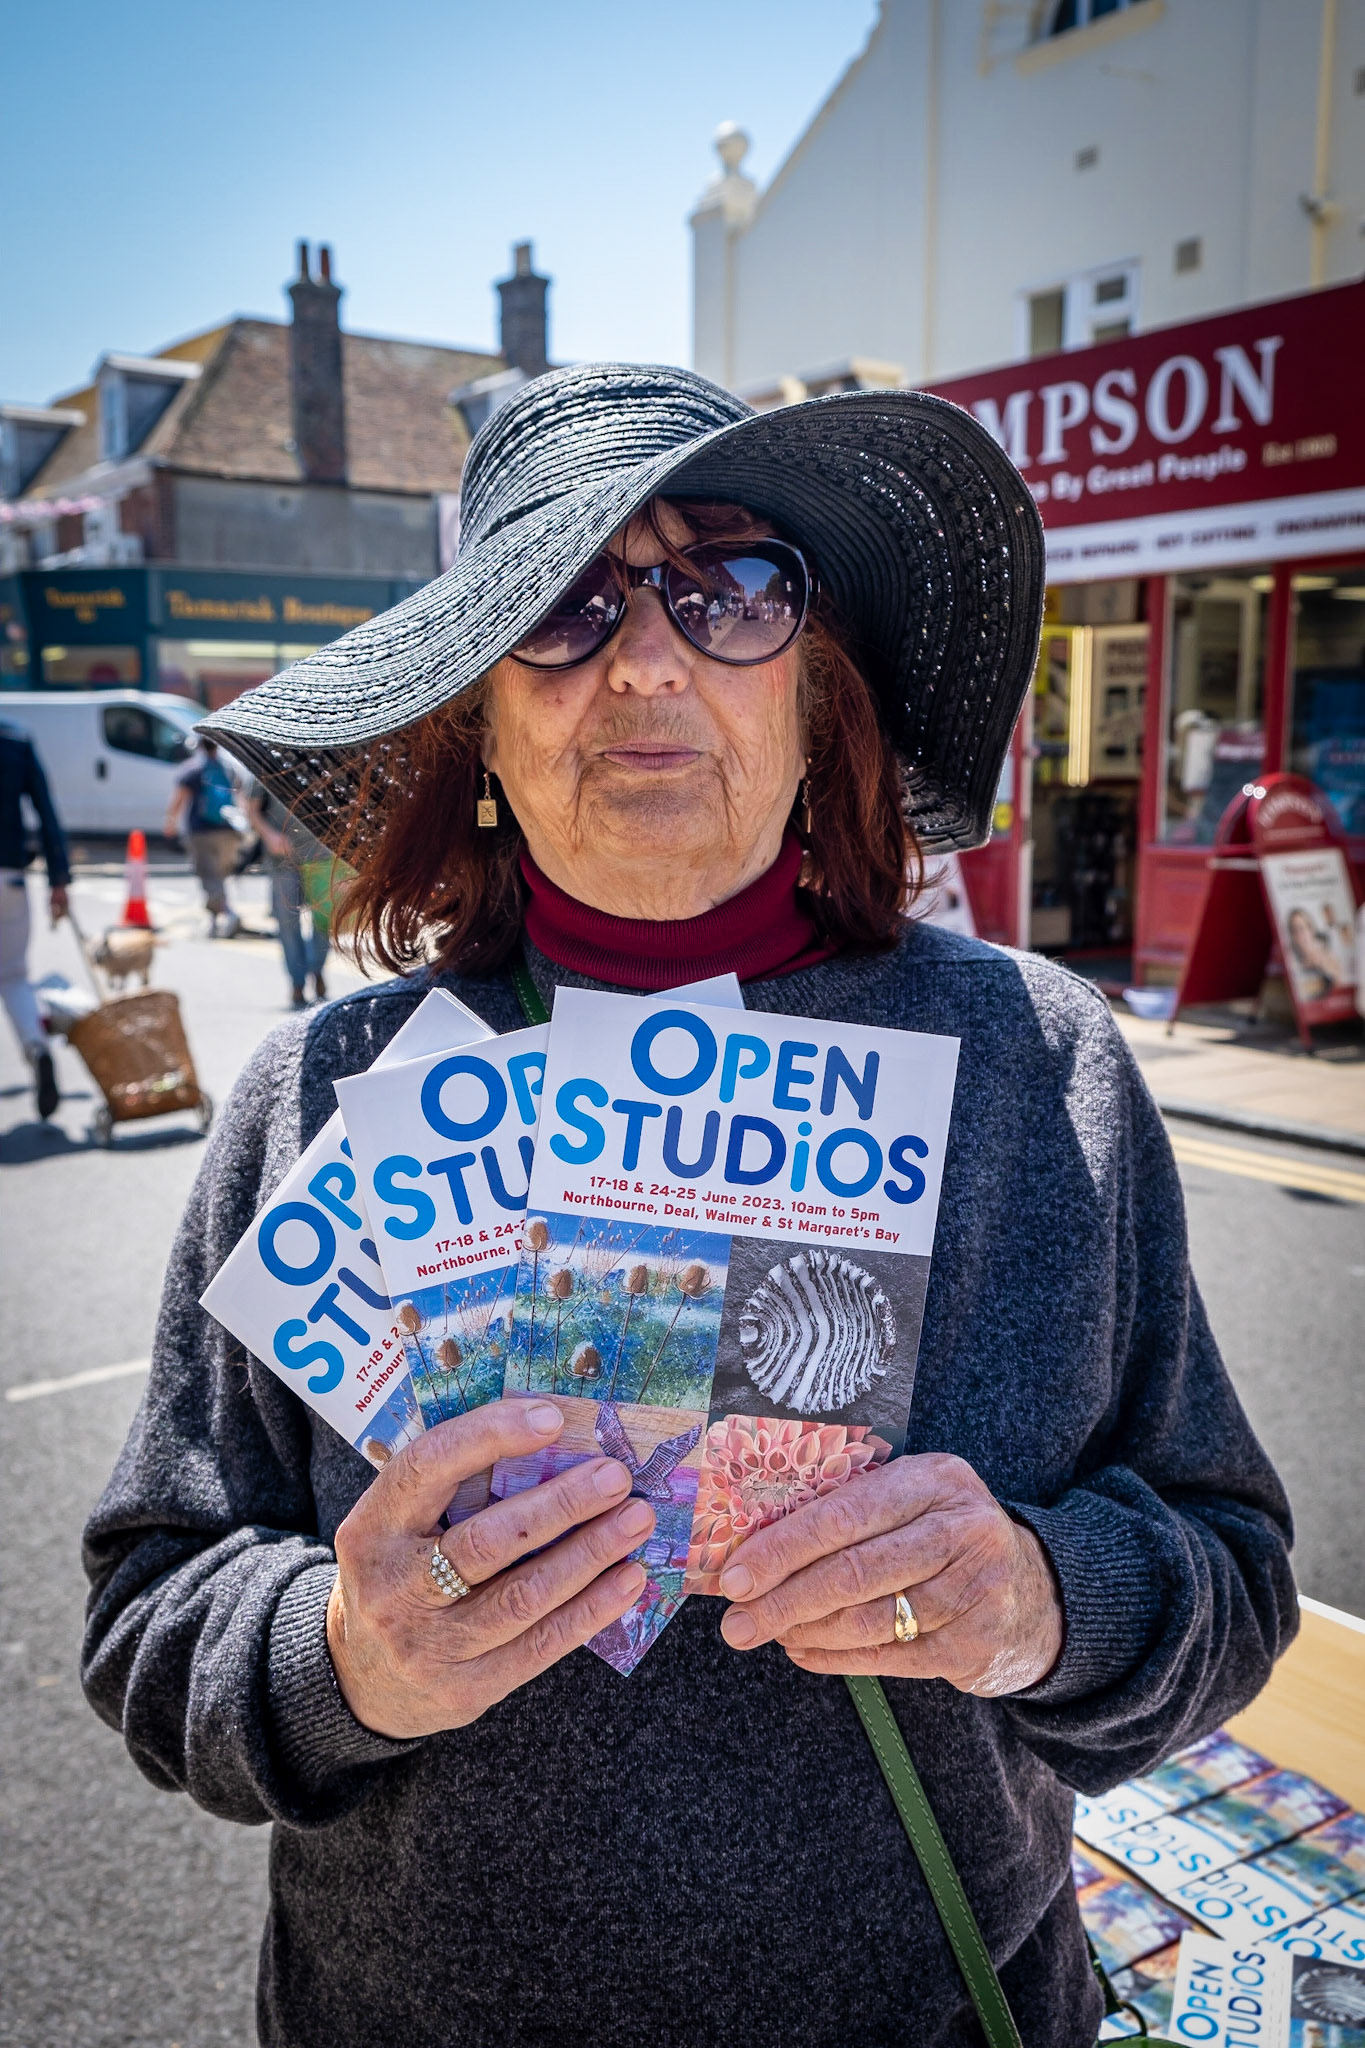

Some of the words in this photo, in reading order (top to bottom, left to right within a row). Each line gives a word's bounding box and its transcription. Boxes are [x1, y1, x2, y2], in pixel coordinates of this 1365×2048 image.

[1051, 470, 1084, 502] By
[1086, 459, 1155, 494] Great
[1157, 444, 1248, 483] People
[630, 1009, 880, 1121] OPEN
[258, 1136, 363, 1287] OP
[562, 1190, 658, 1216] Northbourne,
[663, 1203, 700, 1220] Deal,
[705, 1208, 758, 1226] Walmer
[761, 1215, 772, 1228] &
[777, 1217, 793, 1230] St
[875, 1228, 901, 1244] Bay
[590, 1176, 629, 1191] 17-18
[633, 1181, 644, 1194] &
[649, 1183, 697, 1200] 24-25
[701, 1190, 737, 1206] June
[741, 1195, 786, 1211] 2023.
[791, 1201, 827, 1216] 10am
[832, 1205, 846, 1218] to
[850, 1207, 880, 1223] 5pm
[416, 1245, 511, 1278] Northbourne,
[434, 1233, 475, 1255] 17-18
[478, 1230, 490, 1243] &
[355, 1349, 384, 1383] 17-18
[381, 1338, 394, 1351] &
[1176, 1958, 1225, 2041] OPEN
